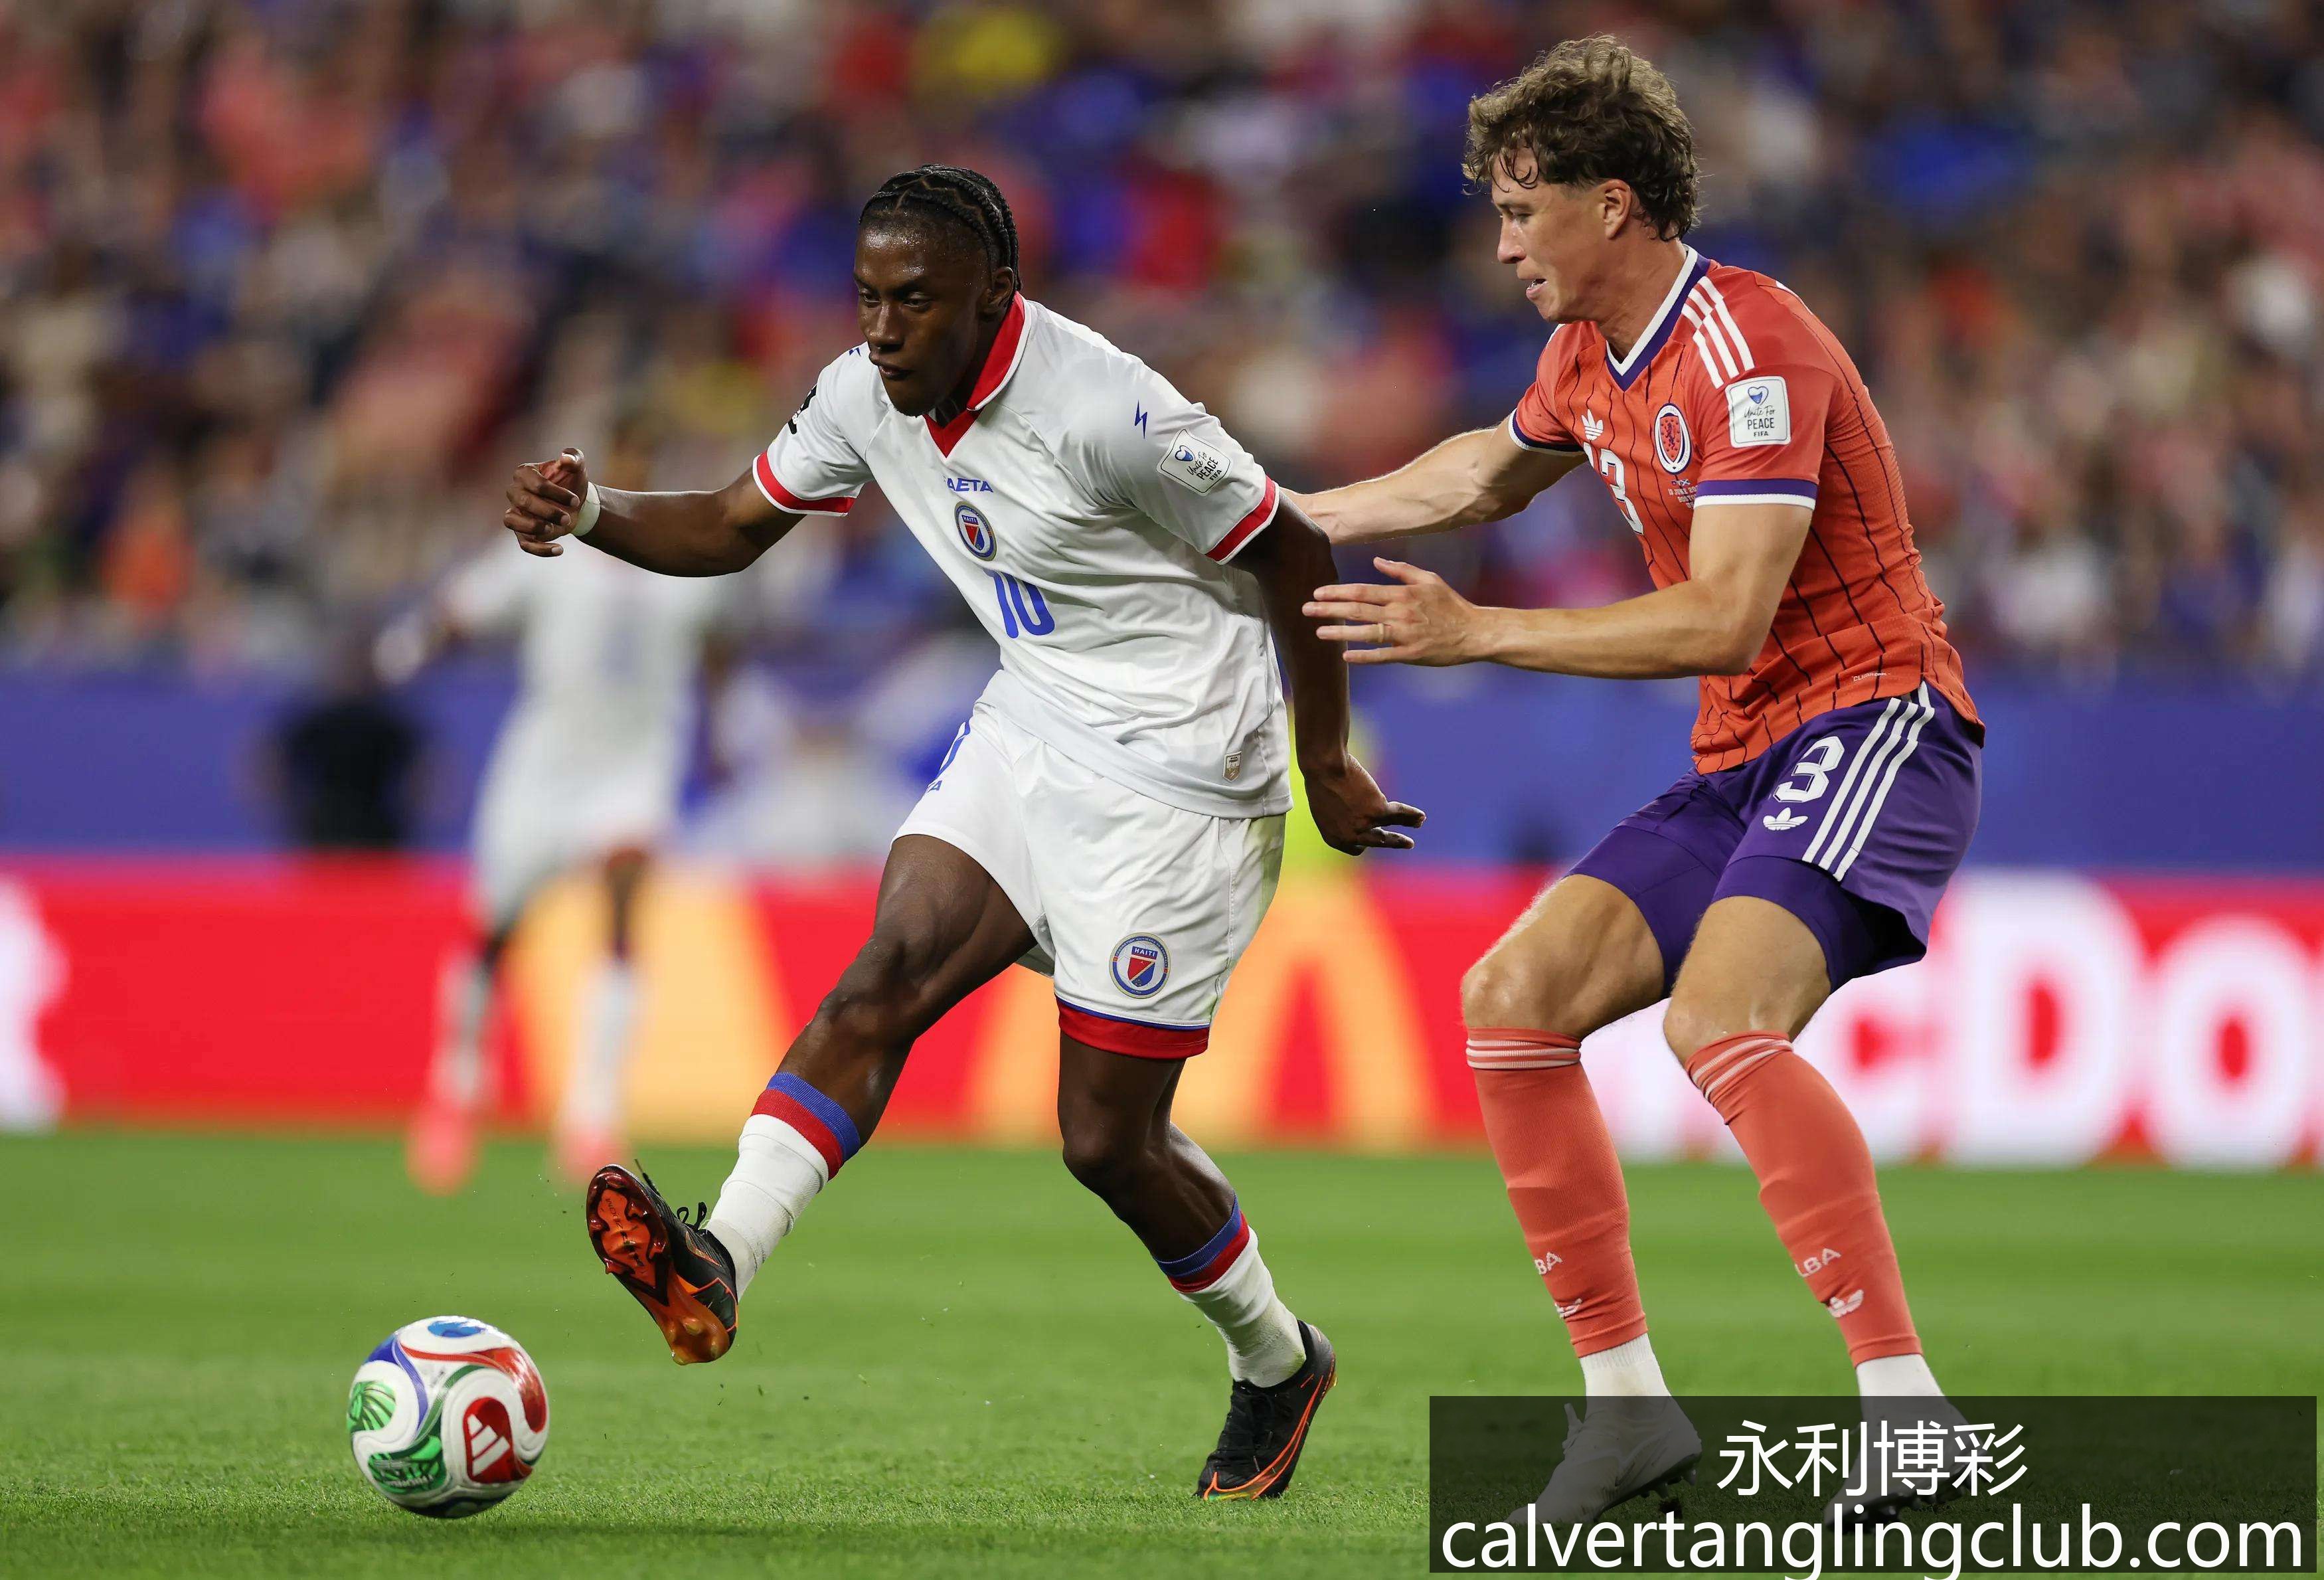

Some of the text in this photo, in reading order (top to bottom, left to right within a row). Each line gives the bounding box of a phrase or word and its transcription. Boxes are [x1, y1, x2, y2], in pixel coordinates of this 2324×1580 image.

[1744, 406, 1764, 418] Unite
[1747, 418, 1775, 430] PEACE
[1196, 457, 1218, 480] PEACE
[1210, 470, 1222, 481] FIFA
[943, 475, 993, 492] AETA
[983, 568, 1055, 639] 10
[1134, 948, 1155, 957] HAITI
